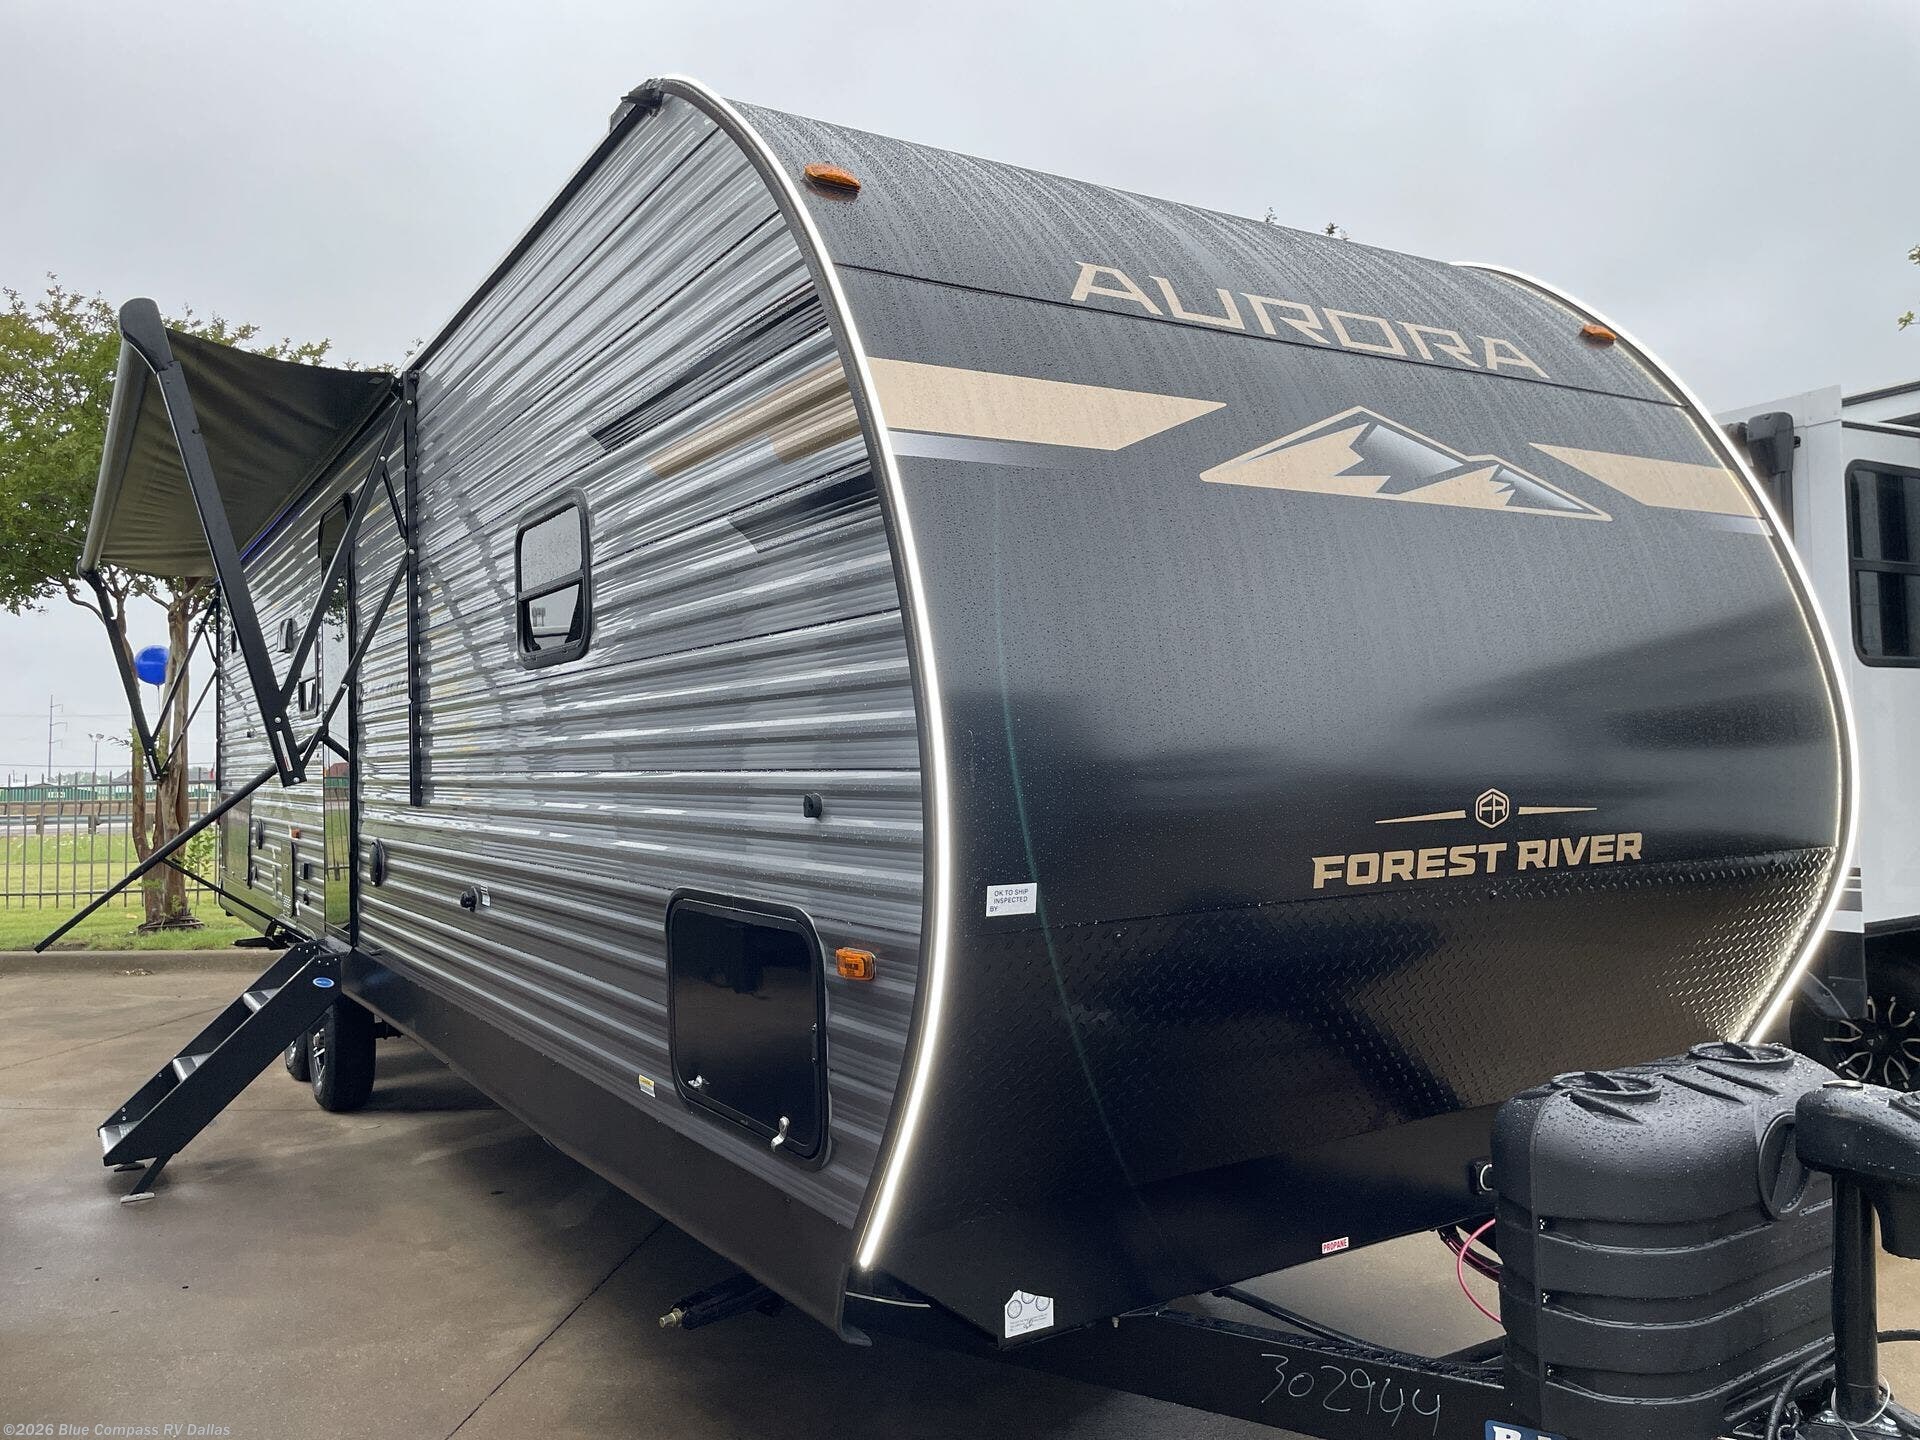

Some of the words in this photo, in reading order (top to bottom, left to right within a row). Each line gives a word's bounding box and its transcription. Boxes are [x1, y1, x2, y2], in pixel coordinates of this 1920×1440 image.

[1070, 261, 1551, 380] AURORA
[1311, 842, 1508, 890] FOREST
[1517, 832, 1643, 871] RIVER
[989, 905, 998, 913] BY
[993, 896, 1027, 904] INSPECTED
[1323, 1239, 1347, 1252] PROPANE
[1260, 1352, 1441, 1437] 302944
